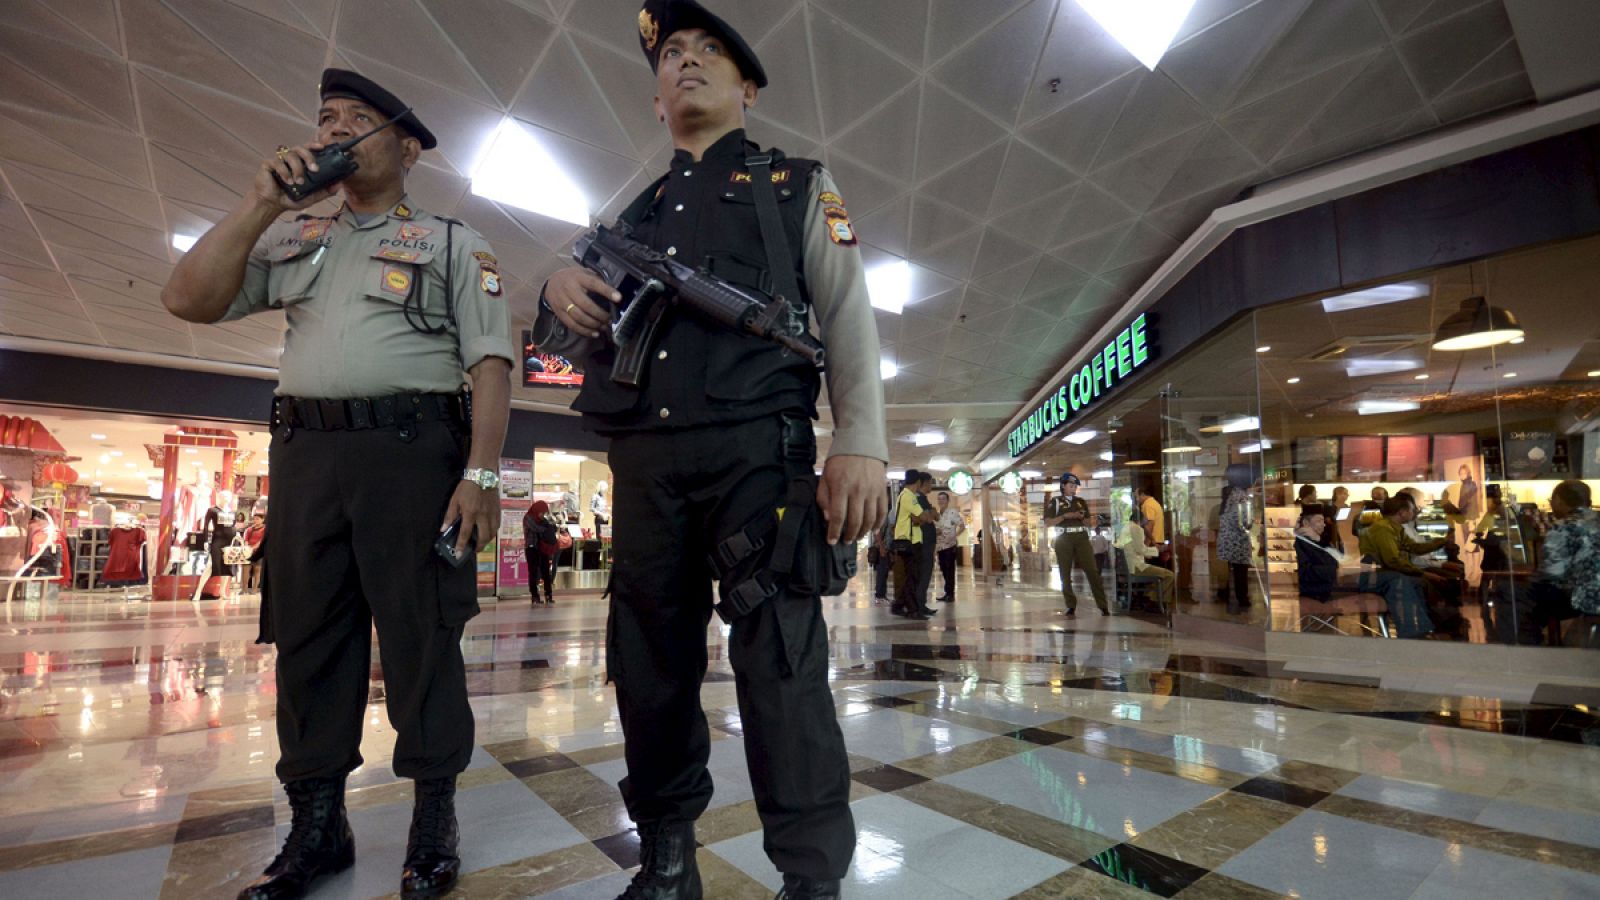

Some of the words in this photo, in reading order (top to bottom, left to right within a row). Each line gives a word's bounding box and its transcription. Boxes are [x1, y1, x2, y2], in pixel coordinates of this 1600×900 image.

[735, 171, 786, 183] POSI
[379, 238, 435, 252] POLISI
[1007, 385, 1068, 458] STARBUCKS
[1069, 312, 1148, 411] COFFEE
